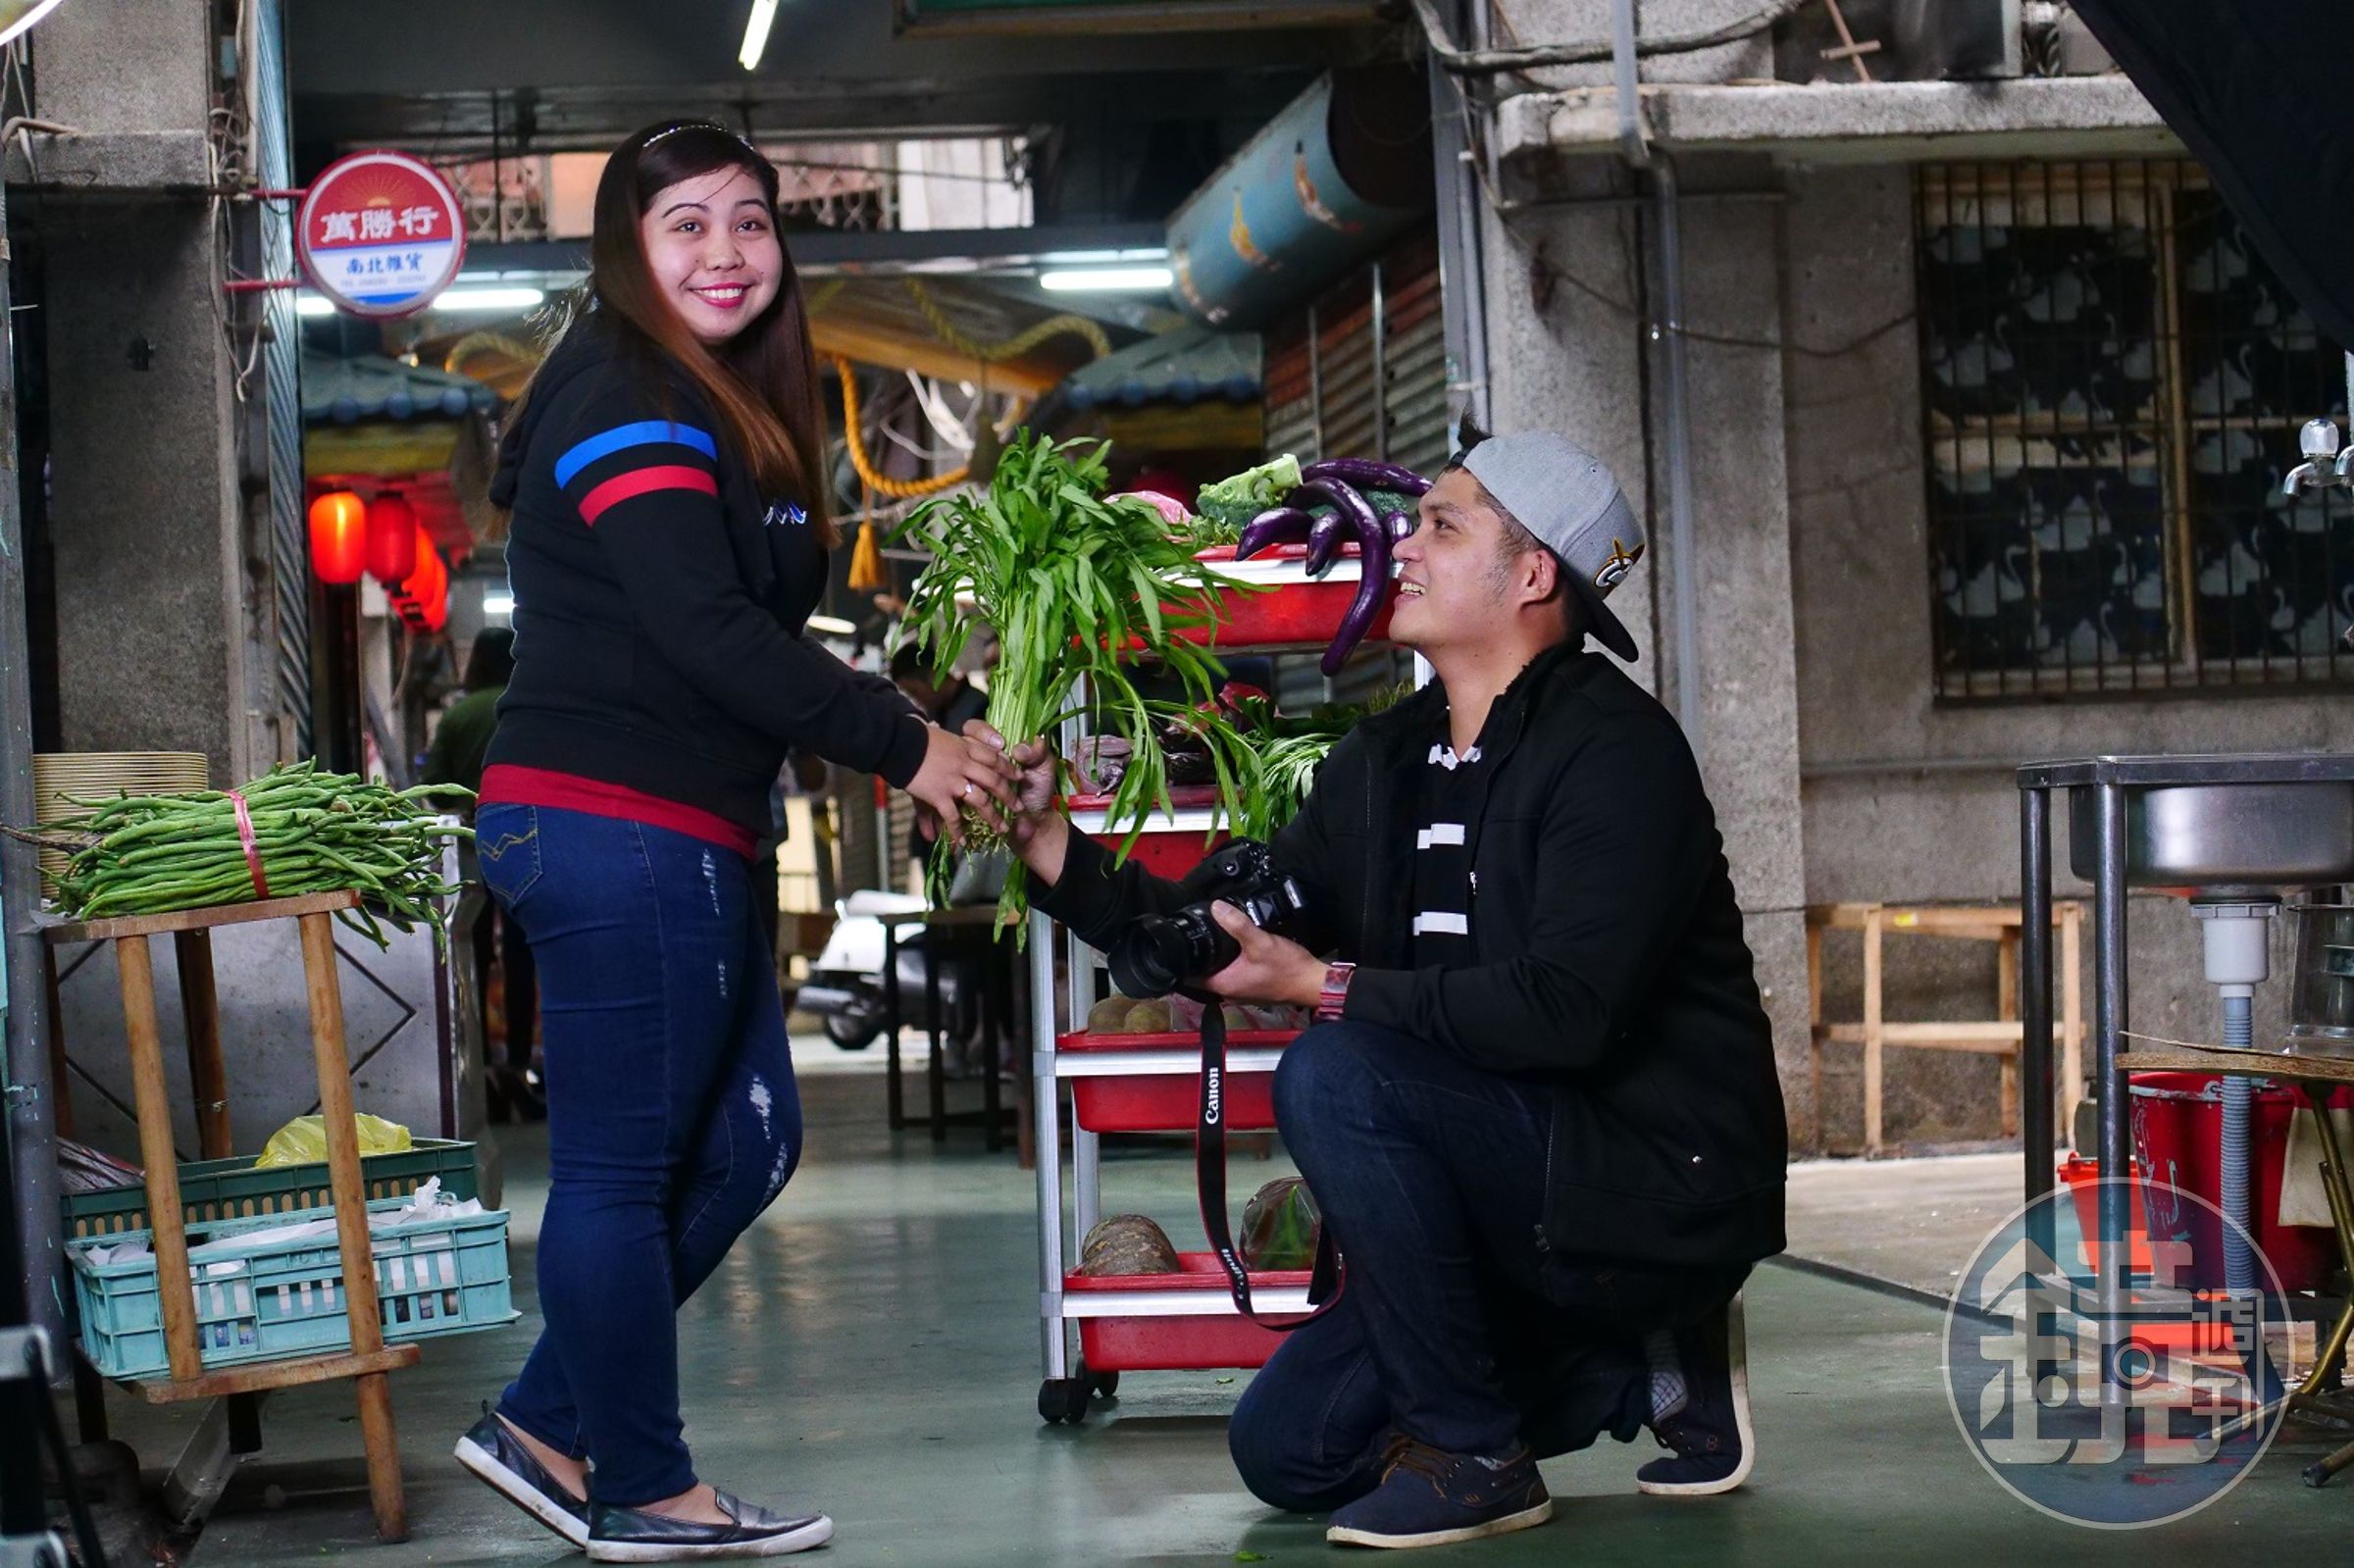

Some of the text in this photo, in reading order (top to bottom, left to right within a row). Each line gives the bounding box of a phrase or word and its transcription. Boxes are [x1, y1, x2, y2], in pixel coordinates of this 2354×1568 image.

[321, 206, 439, 243] 萬勝行
[346, 252, 423, 275] 南北雜貨
[1205, 1067, 1219, 1124] Canon
